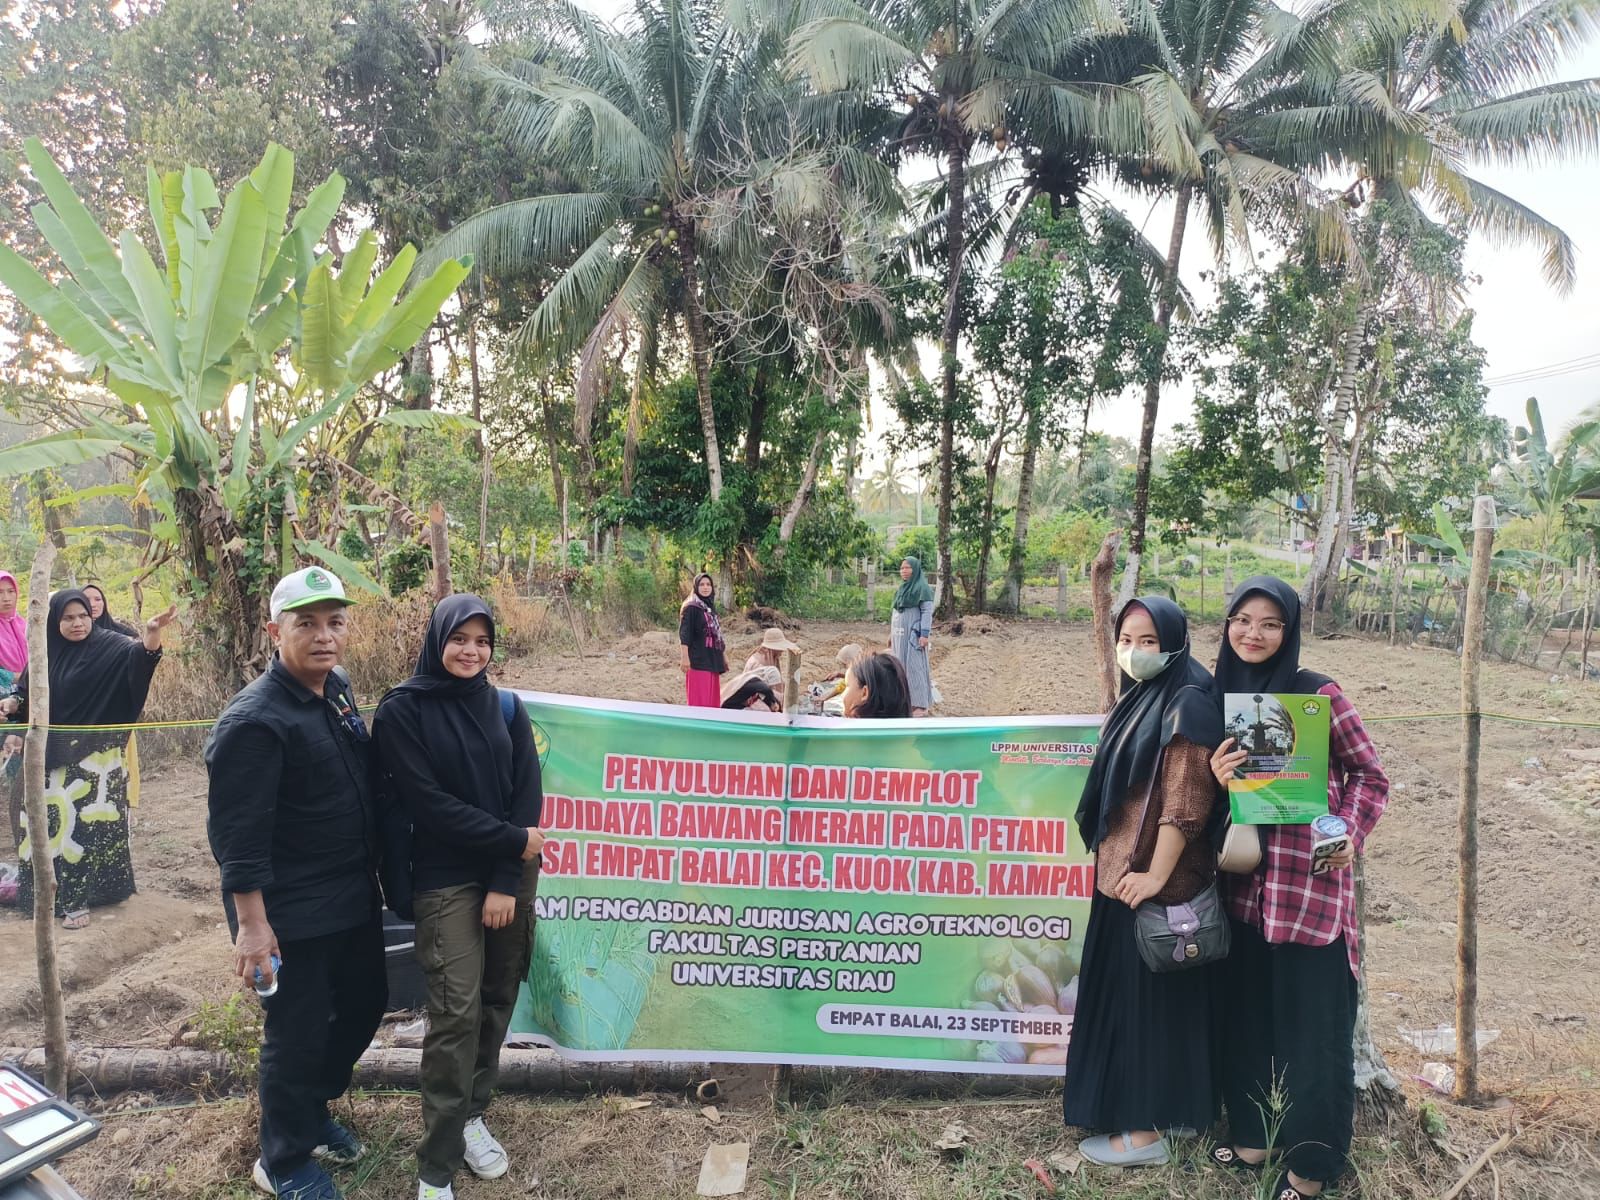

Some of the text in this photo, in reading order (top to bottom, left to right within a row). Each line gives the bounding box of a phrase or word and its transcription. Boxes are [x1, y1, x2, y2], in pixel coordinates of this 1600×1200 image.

[991, 742, 1021, 753] LPPM
[1022, 742, 1094, 755] UNIVERSITAS
[604, 755, 981, 806] PENYULUHAN DAN DEMPLOT
[538, 794, 1067, 855] UDIDAYA BAWANG MERAH PADA PETANI
[542, 840, 580, 876] SA
[584, 842, 677, 883] EMPAT
[679, 848, 761, 887] BALAI
[767, 852, 829, 890] KEC.
[833, 854, 914, 893] KUOK
[916, 858, 983, 898] KAB.
[534, 896, 1072, 940] AM PENGABDIAN JURUSAN AGROTEKNOLOGI
[648, 929, 922, 965] FAKULTAS PERTANIAN
[671, 962, 896, 993] UNIVERSITAS RIAU
[829, 1010, 887, 1028] EMPAT
[889, 1013, 943, 1031] BALAI,
[946, 1016, 967, 1032] 23
[969, 1017, 1063, 1036] SEPTEMBER
